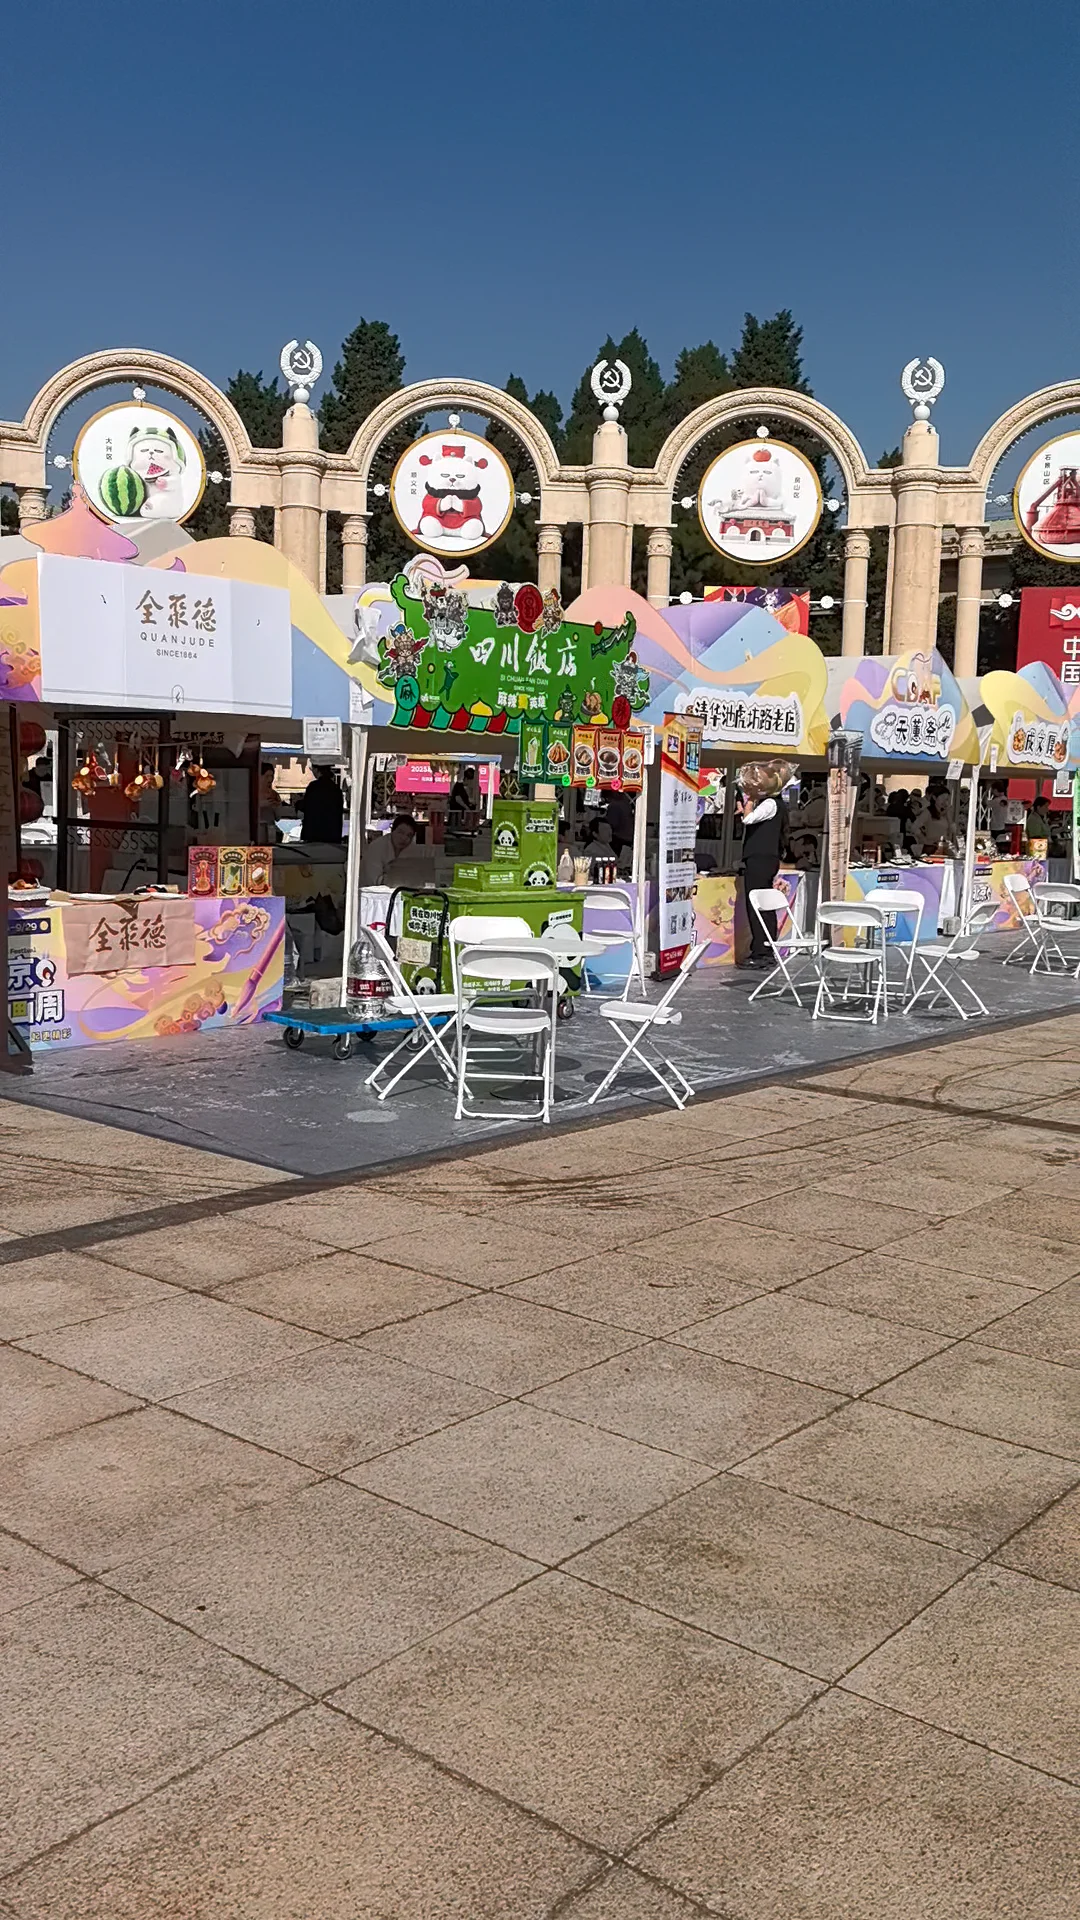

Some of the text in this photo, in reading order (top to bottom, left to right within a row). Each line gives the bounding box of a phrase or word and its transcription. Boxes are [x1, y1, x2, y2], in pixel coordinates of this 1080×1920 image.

[135, 590, 216, 632] 全聚德
[140, 632, 214, 647] QUANJUDE
[156, 649, 197, 659] SINCE1864
[695, 701, 795, 732] 清华池虎坊路老店
[88, 914, 166, 952] 全聚德
